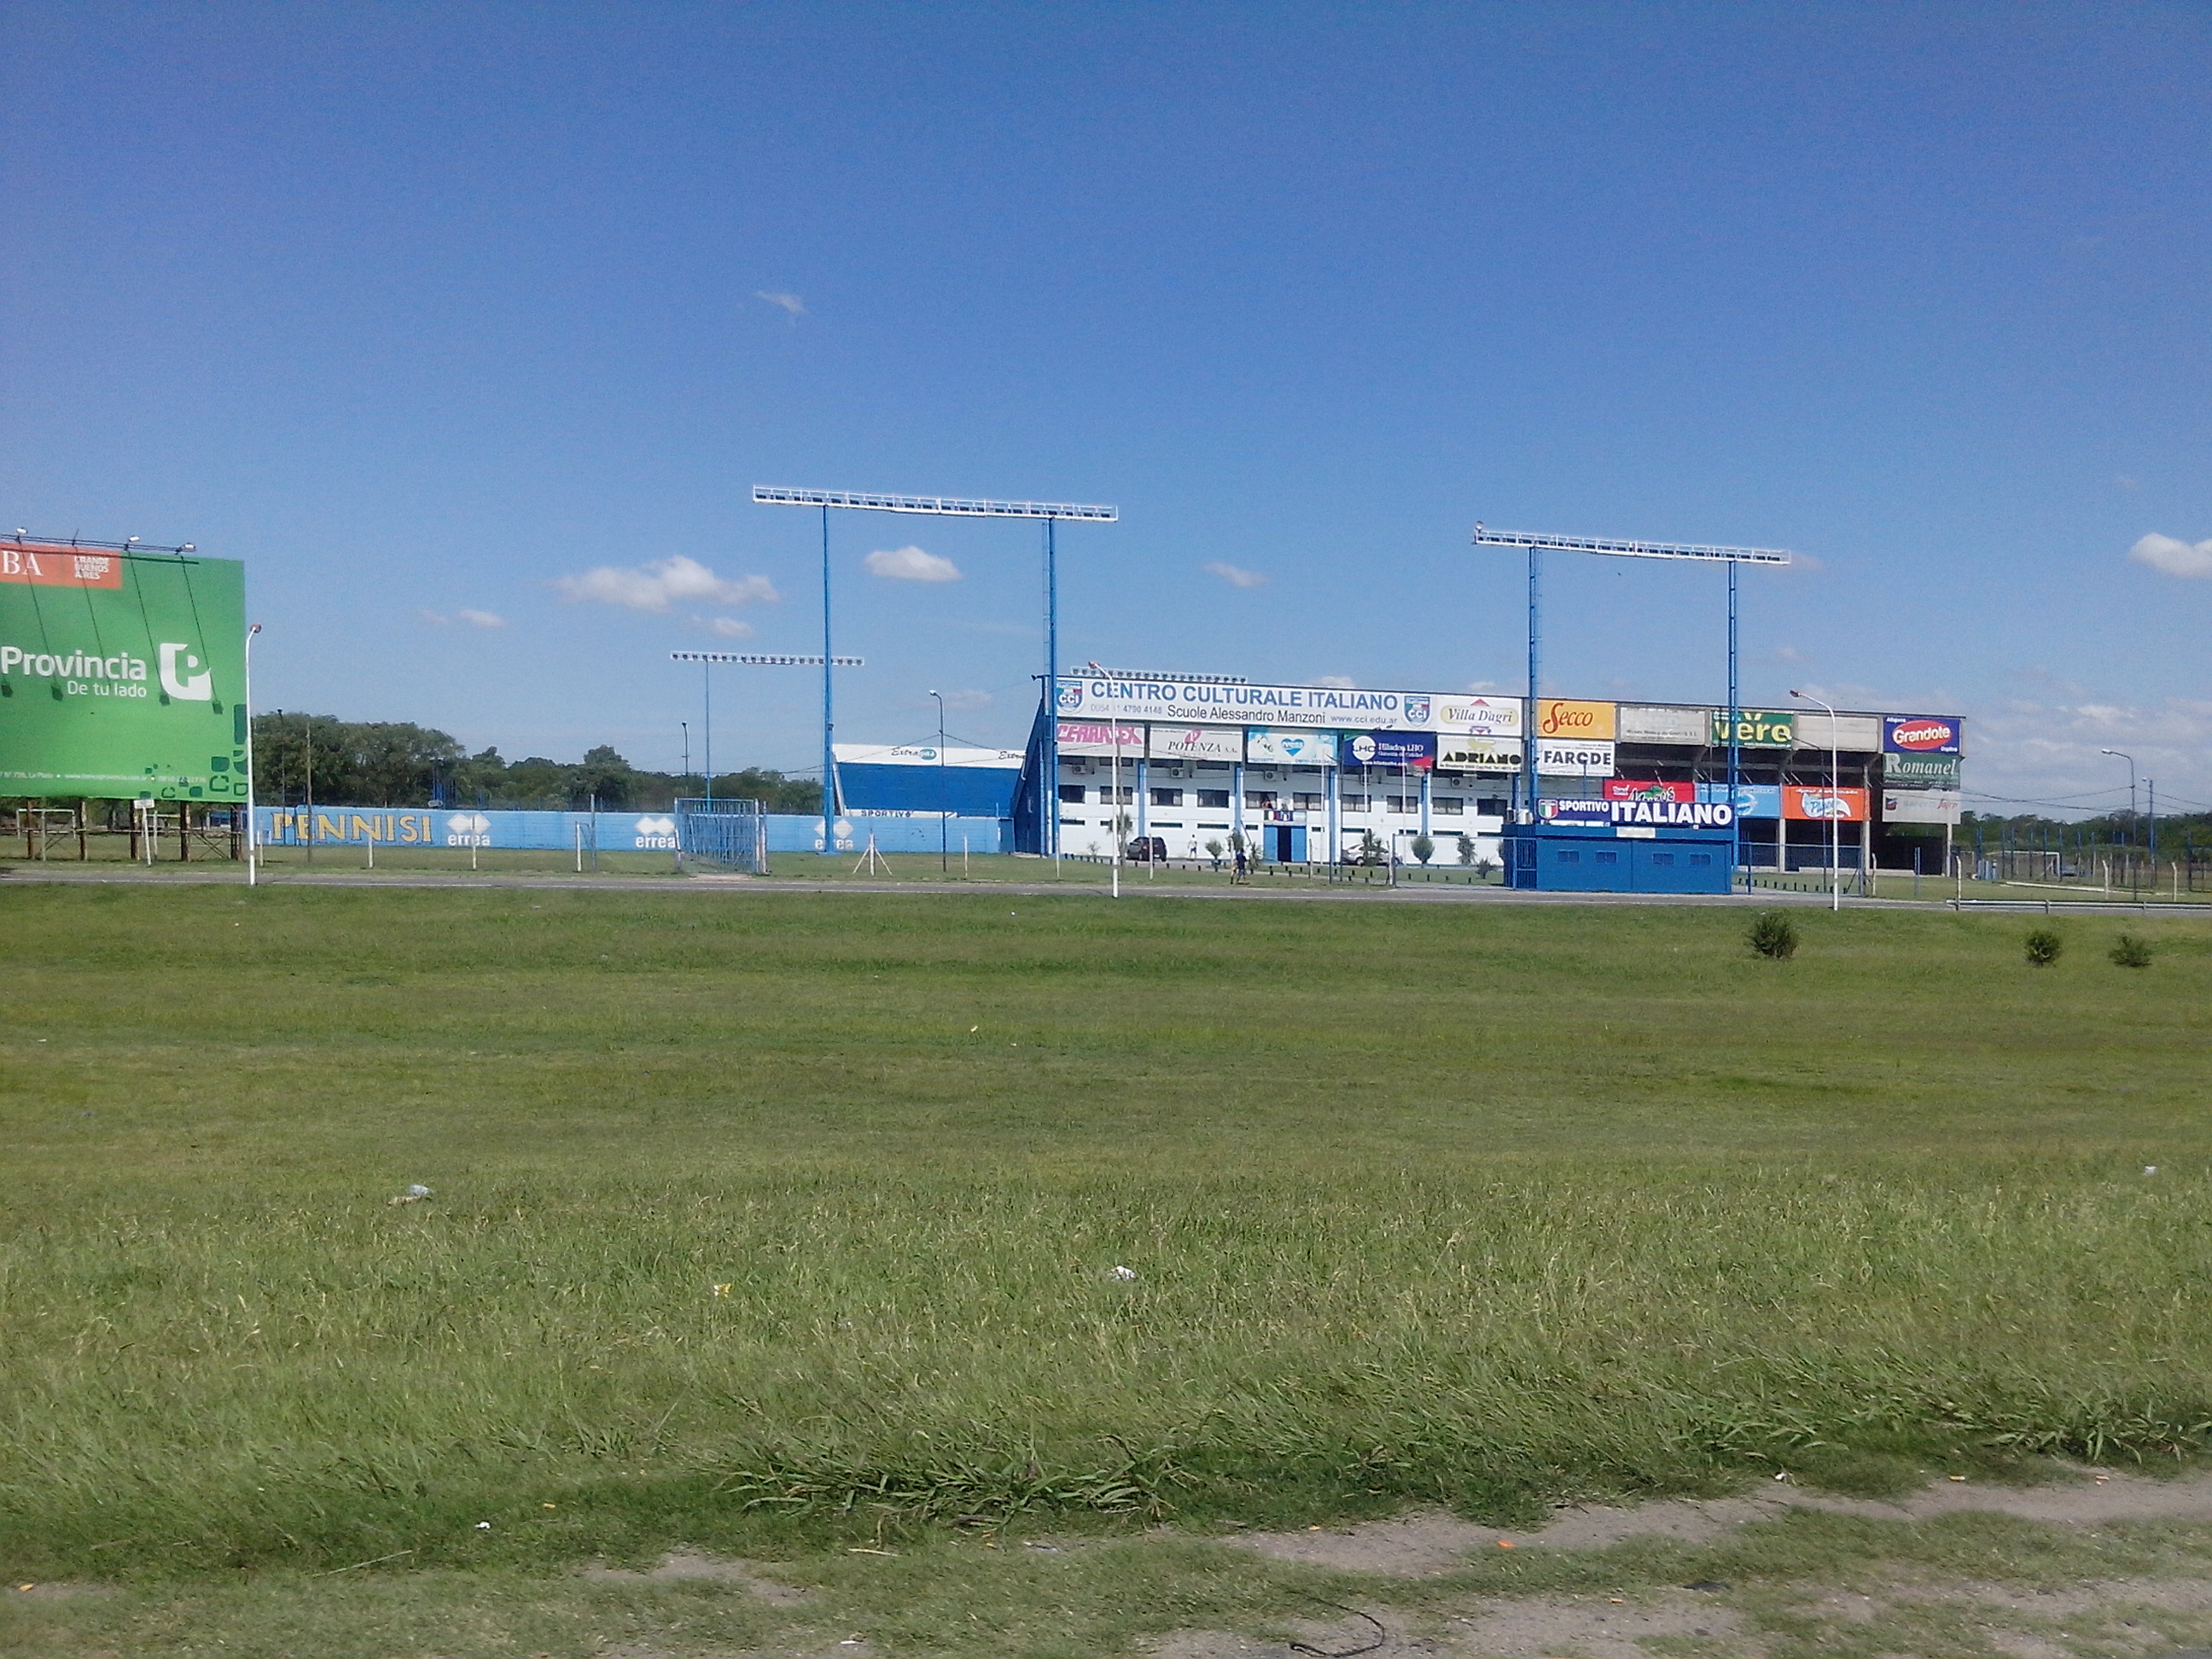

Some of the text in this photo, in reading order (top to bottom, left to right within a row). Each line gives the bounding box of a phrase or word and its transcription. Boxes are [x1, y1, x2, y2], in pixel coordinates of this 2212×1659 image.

[2, 551, 44, 577] BA
[1, 646, 147, 680] Provincia
[67, 681, 147, 697] De tu lado
[1091, 682, 1398, 711] CENTRO CULTURALE ITALIANO
[1059, 695, 1079, 704] CCI
[1167, 704, 1207, 719] Scuole
[1209, 707, 1274, 722] Alessandro
[1278, 710, 1326, 725] Manzoni
[1408, 710, 1427, 719] CCI
[1448, 708, 1475, 721] Villa
[1542, 702, 1593, 734] Secco
[1893, 726, 1951, 745] Grandote
[1167, 741, 1221, 754] POTENZA
[1442, 752, 1522, 765] ADRIANO
[1883, 753, 1957, 775] Romanel
[1558, 800, 1610, 814] SPORTIVO
[1611, 803, 1732, 825] ITALIANO
[272, 812, 433, 842] PENNISI
[447, 832, 491, 847] errea
[635, 835, 676, 849] errea
